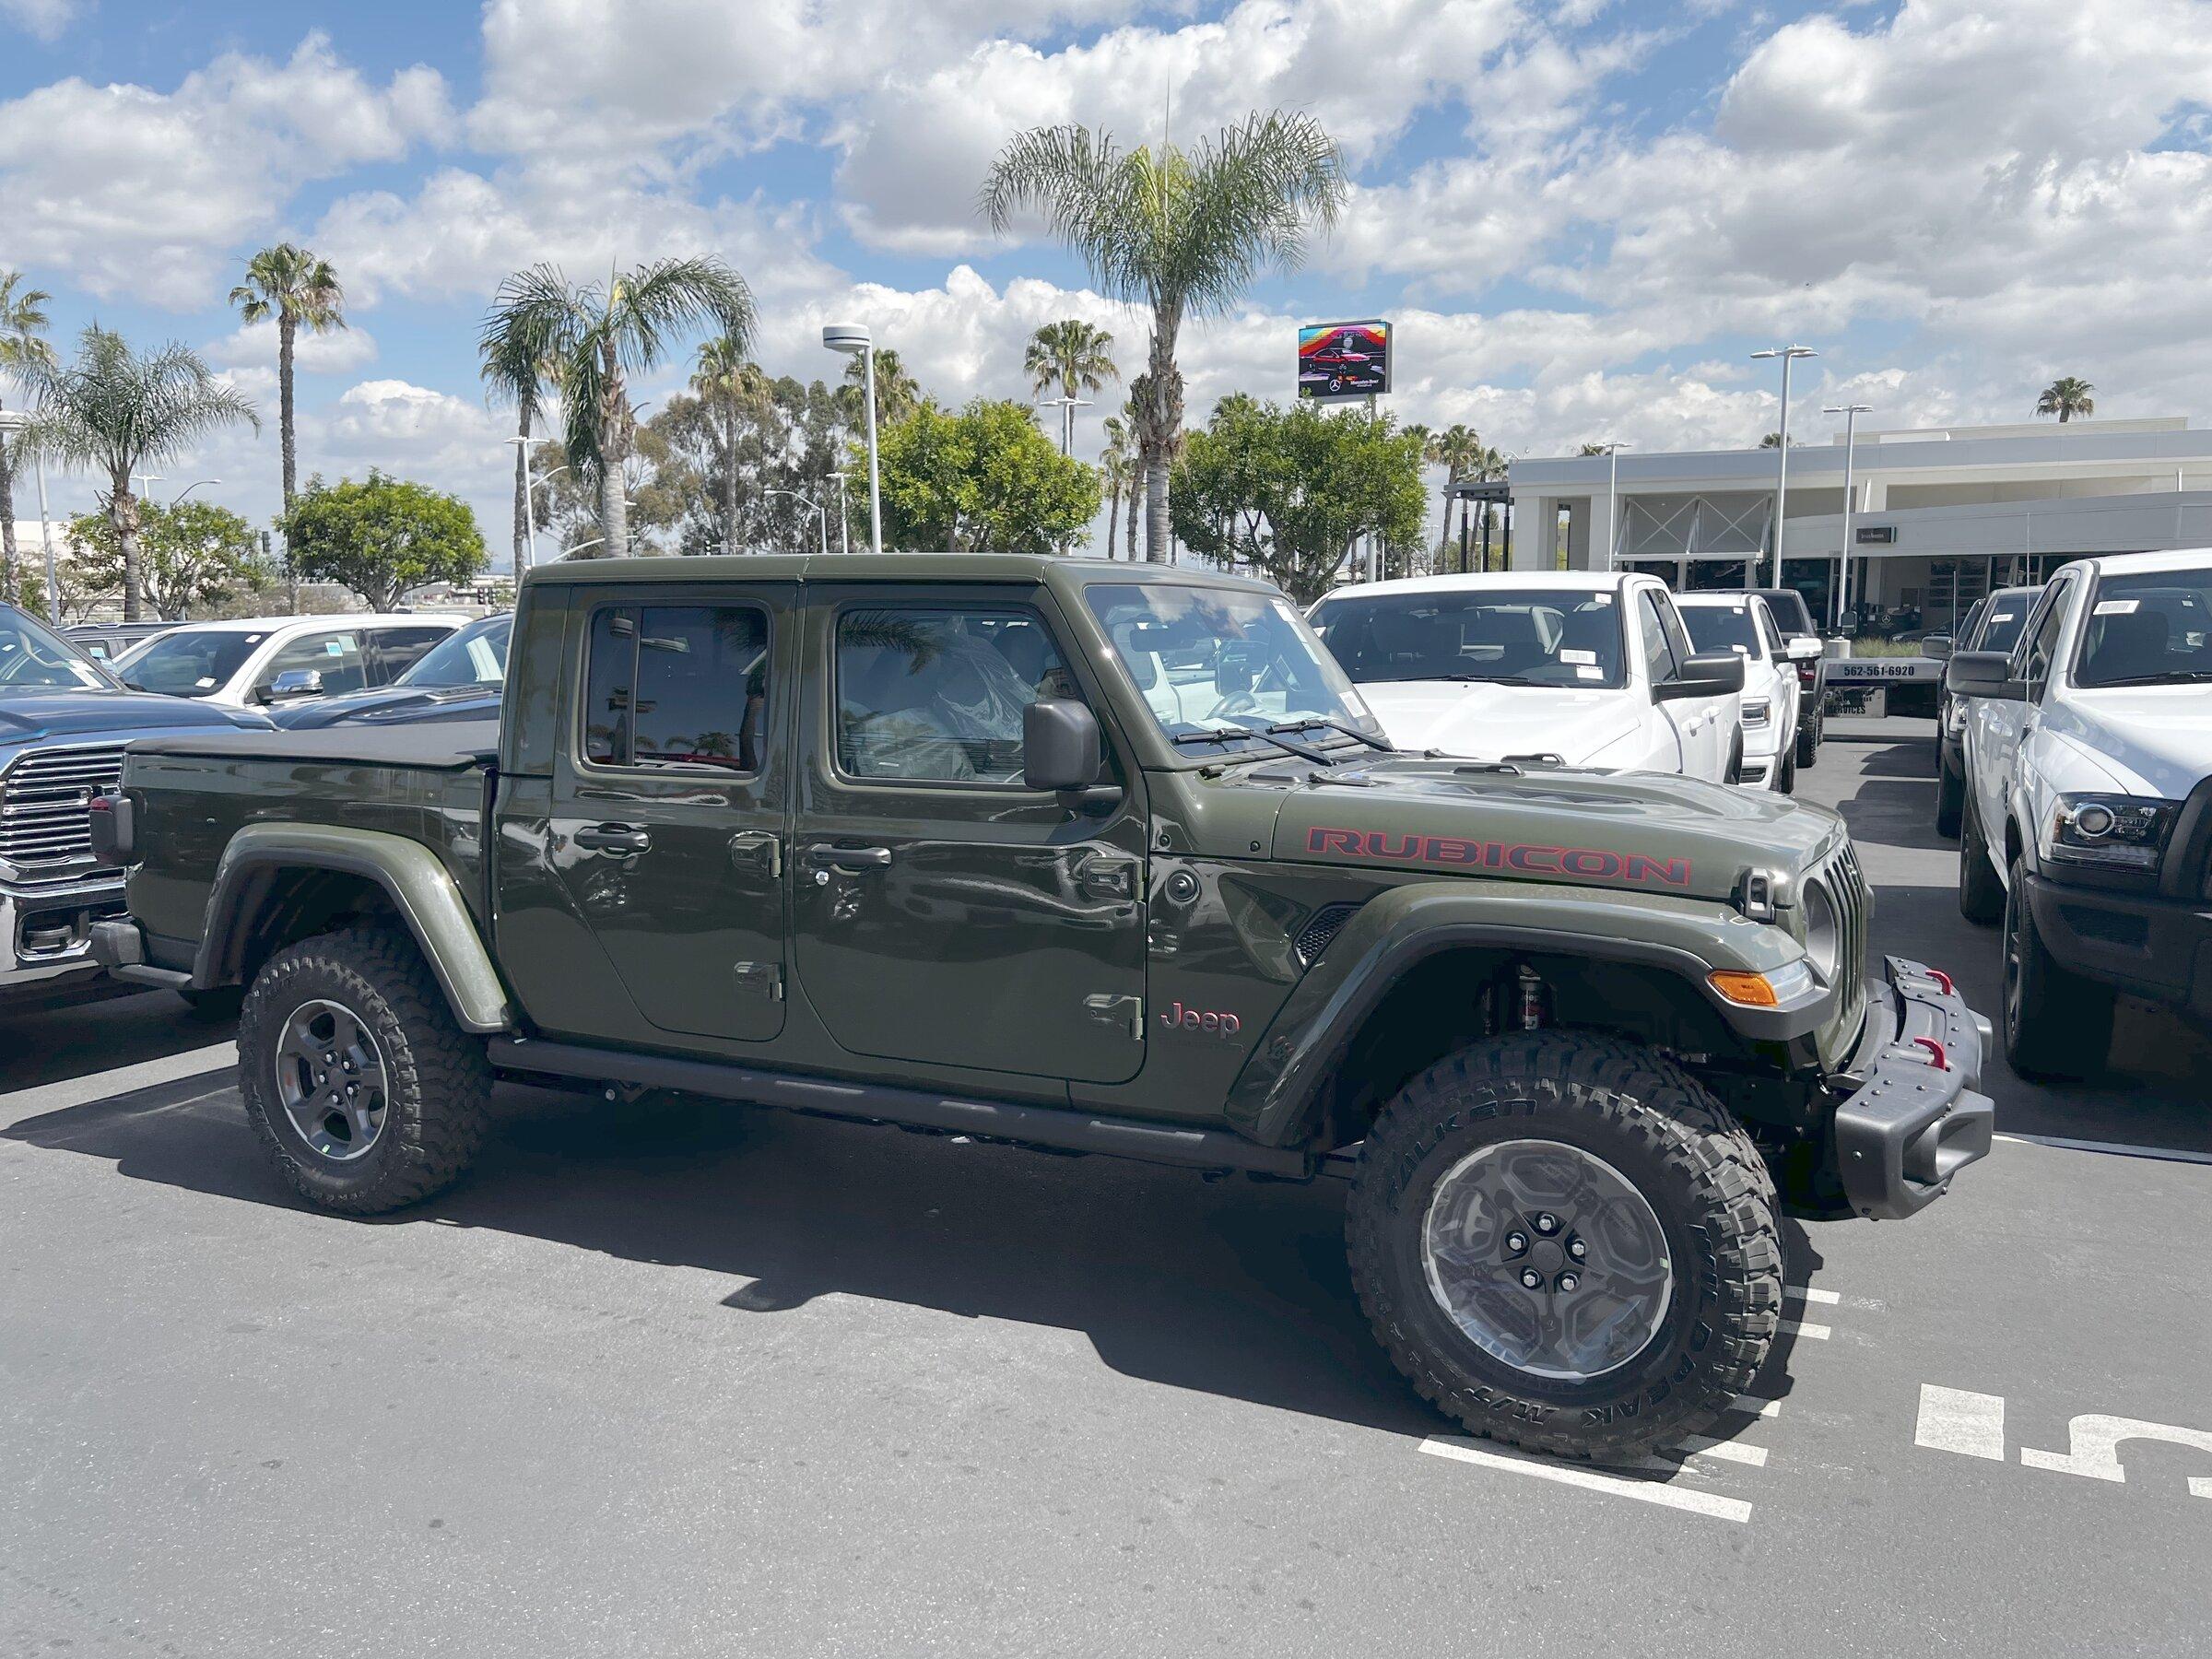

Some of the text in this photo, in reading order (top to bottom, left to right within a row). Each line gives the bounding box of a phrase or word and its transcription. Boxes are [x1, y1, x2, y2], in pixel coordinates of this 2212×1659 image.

[1843, 665, 1914, 677] 562-561-6920
[1307, 827, 1691, 887] RUBICON
[1160, 1002, 1241, 1040] Jeep
[1463, 1384, 1560, 1426] M/T
